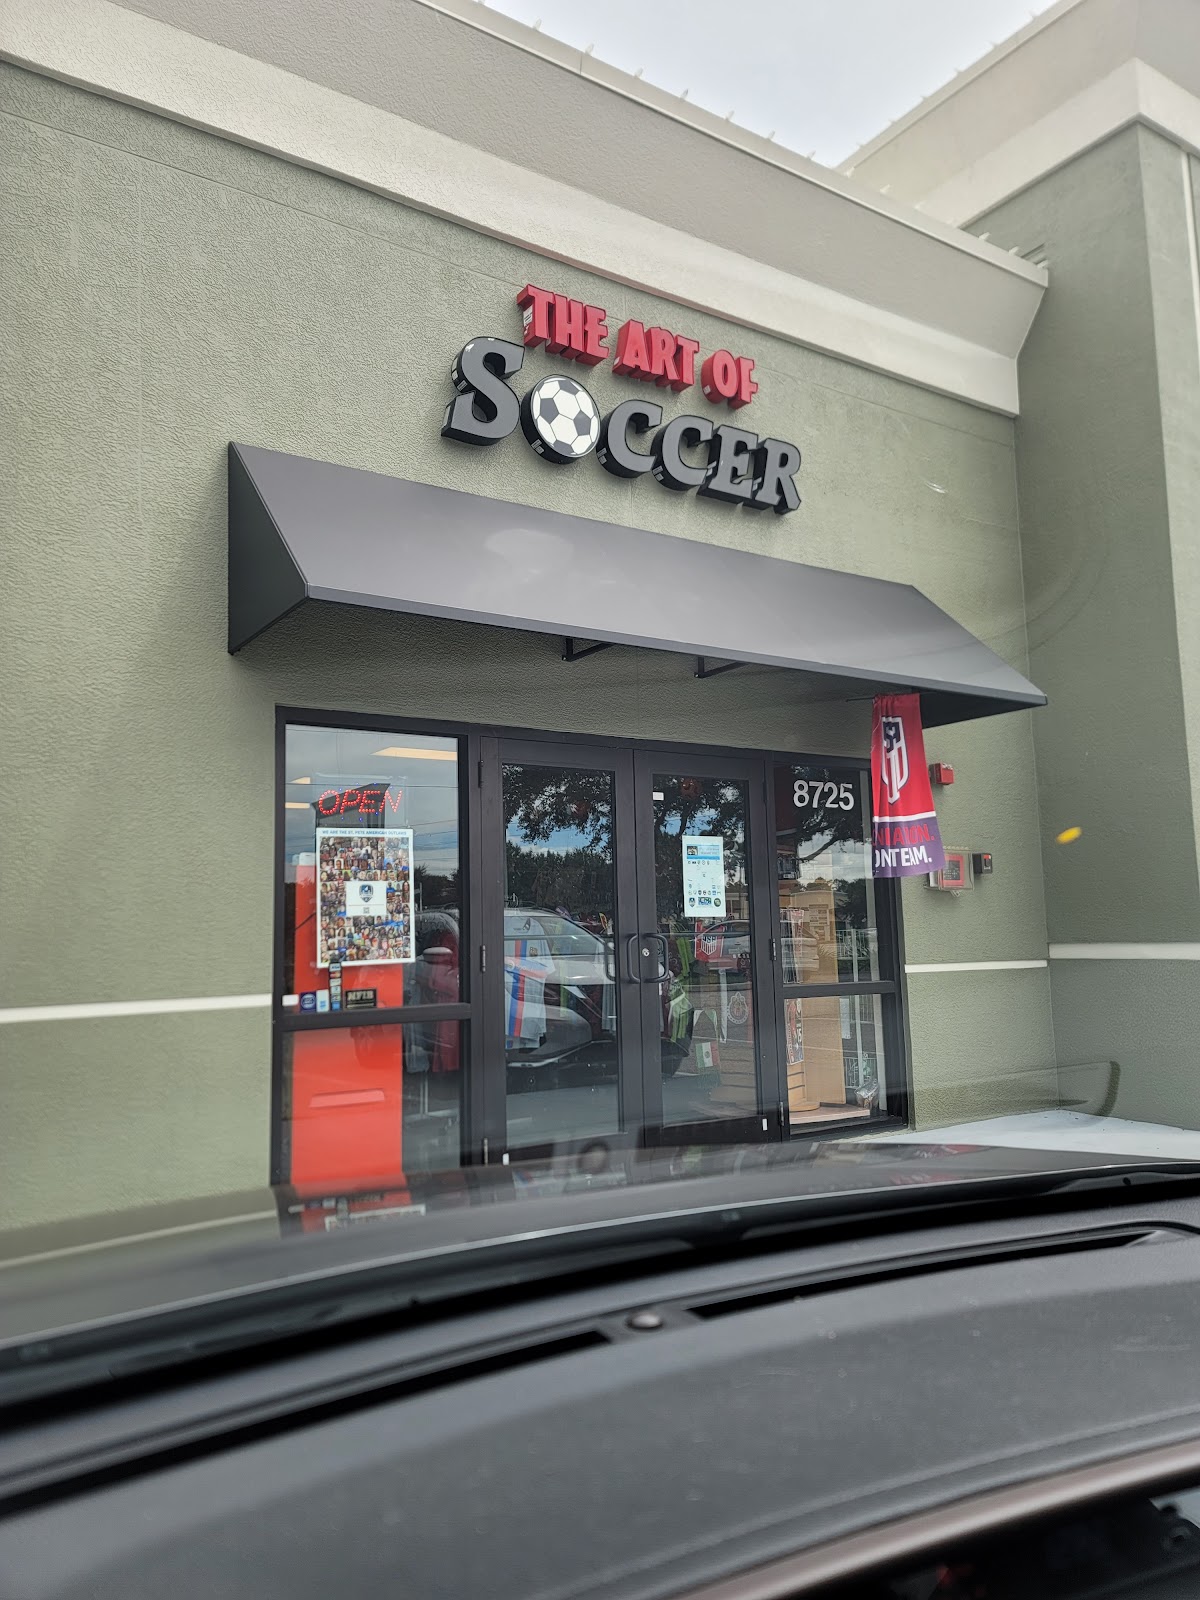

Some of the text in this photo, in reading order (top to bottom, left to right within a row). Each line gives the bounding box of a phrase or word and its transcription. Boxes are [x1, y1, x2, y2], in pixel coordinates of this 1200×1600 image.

[517, 284, 759, 410] THE ART OF
[441, 335, 802, 515] SOCCER
[318, 789, 403, 815] OPEN
[793, 780, 855, 810] 8725
